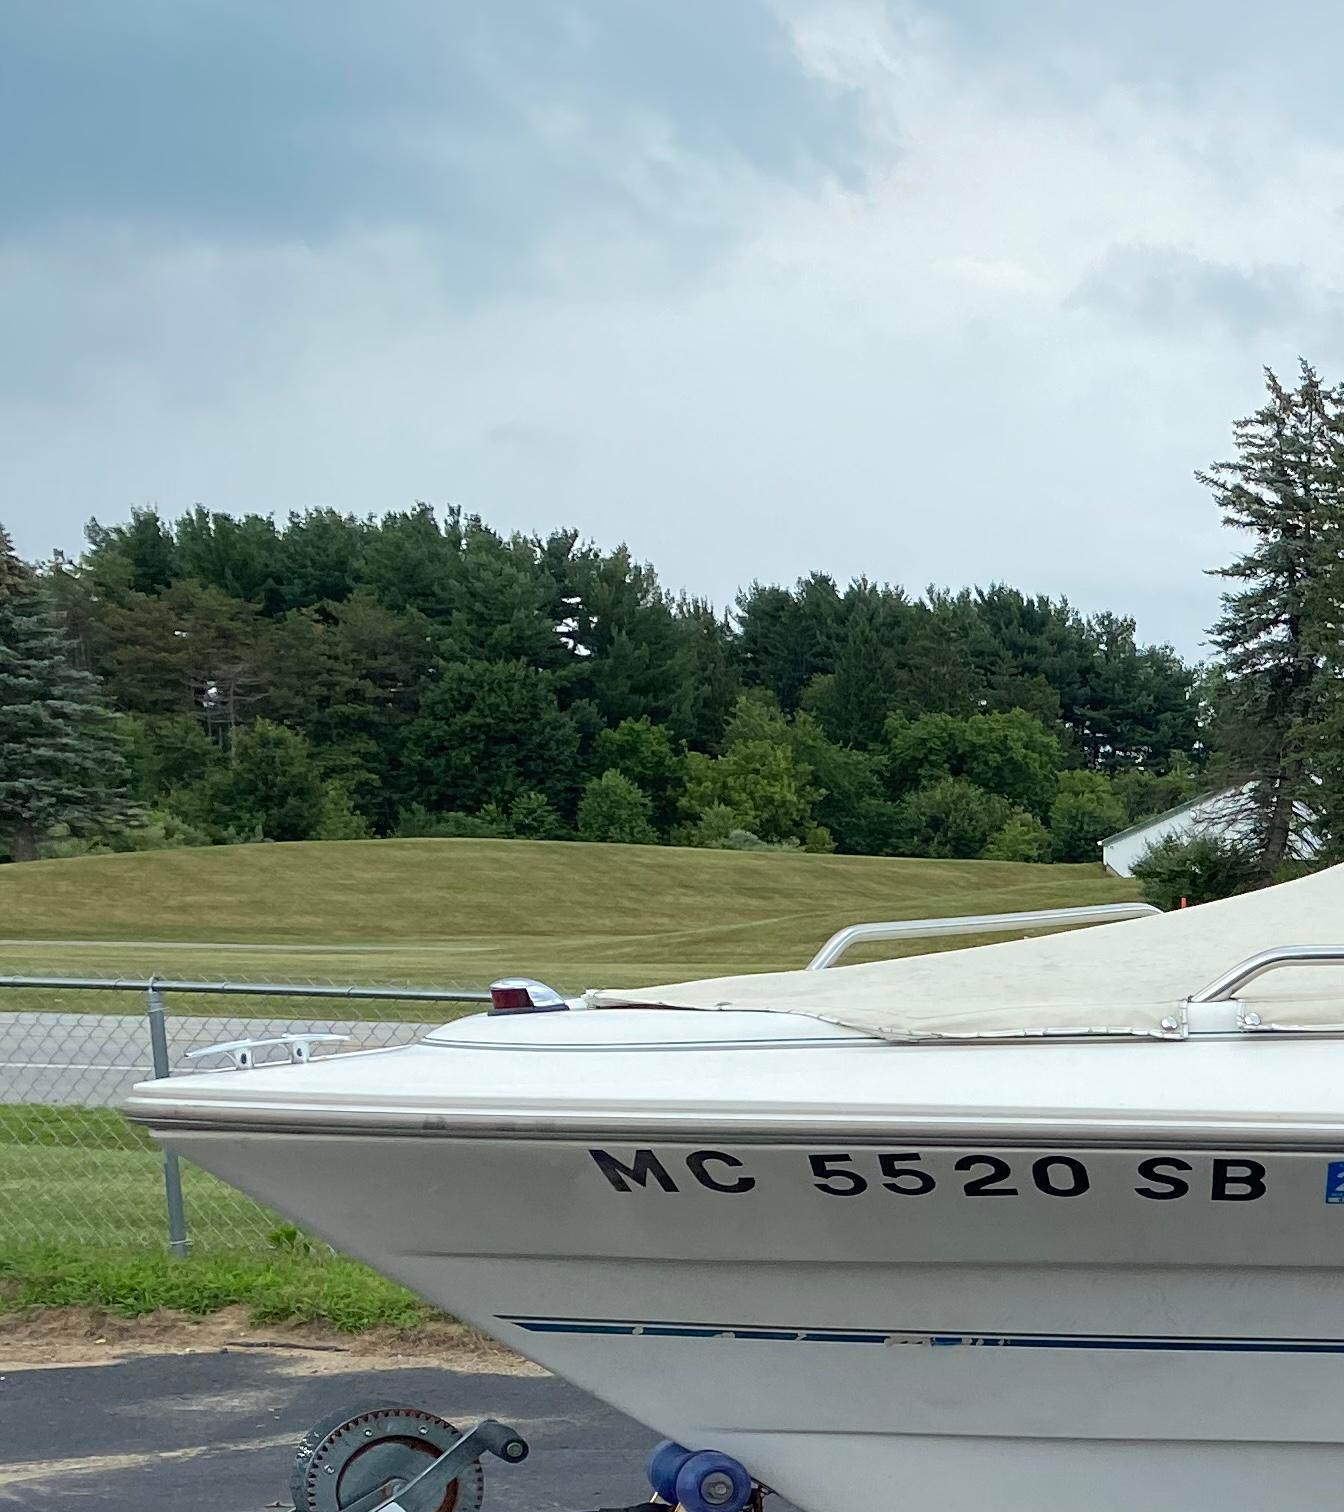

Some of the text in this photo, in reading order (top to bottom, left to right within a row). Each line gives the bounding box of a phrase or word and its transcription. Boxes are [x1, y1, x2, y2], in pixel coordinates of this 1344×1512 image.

[589, 1150, 1267, 1201] MC 5520 SB
